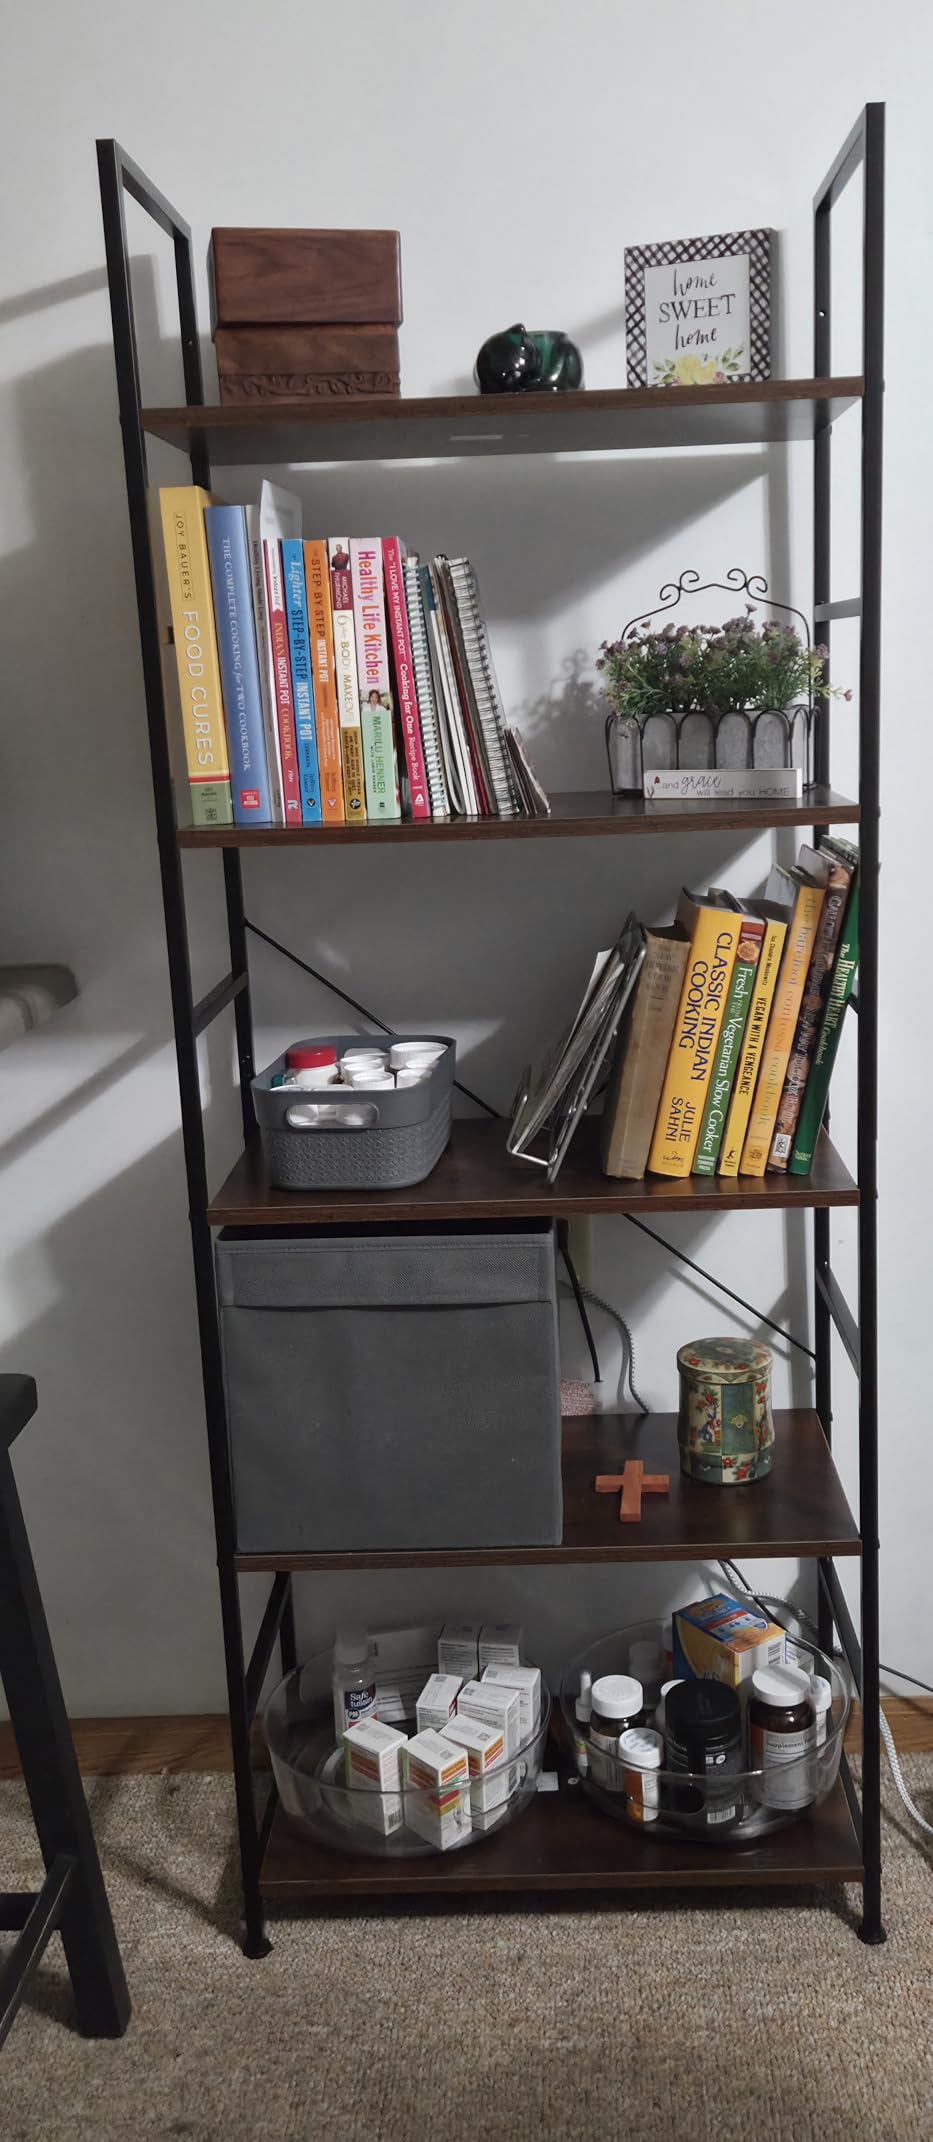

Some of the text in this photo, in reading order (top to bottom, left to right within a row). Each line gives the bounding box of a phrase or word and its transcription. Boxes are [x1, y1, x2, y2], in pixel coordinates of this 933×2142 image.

[673, 268, 718, 297] home
[658, 293, 736, 324] SWEET
[674, 324, 718, 351] home
[175, 513, 192, 600] JOY BAUER'S
[288, 561, 303, 607] Lighter
[334, 572, 342, 609] THURMOND
[341, 576, 349, 604] MICHAEL
[389, 569, 398, 591] LOVE
[392, 592, 399, 603] MY
[358, 551, 383, 684] Healthy Life Kitchen
[394, 605, 403, 637] INSTANT
[181, 610, 204, 677] FOOD
[222, 537, 251, 772] THE COMPLETE COOKING for TWO COOKBOOK
[274, 622, 285, 656] INDIAN
[291, 609, 307, 679] STEP-BY-STEP
[317, 639, 328, 668] INSTANT
[277, 656, 289, 688] INSTANT
[319, 669, 329, 683] POT
[400, 663, 410, 700] Cooking
[279, 690, 290, 705] POT
[296, 682, 311, 720] INSTANT
[404, 701, 412, 714] for
[190, 686, 214, 766] CURES
[280, 707, 293, 760] COOKBOOK
[299, 723, 313, 740] POT
[406, 715, 414, 734] One
[372, 716, 386, 794] MARILU HENNER
[407, 736, 416, 761] Recipe
[411, 762, 419, 781] Book
[680, 775, 722, 796] grace
[759, 787, 790, 797] HOME
[767, 943, 776, 961] Chandra
[787, 927, 812, 985] barefoot
[840, 943, 850, 958] The
[733, 967, 753, 998] Fresh
[762, 962, 772, 986] Moskowitz
[831, 958, 855, 999] HEALTHY
[678, 961, 709, 1049] COOKING
[691, 932, 733, 1081] CLASSIC INDIAN
[735, 1000, 743, 1018] FROM
[754, 997, 768, 1022] VEGAN
[773, 989, 795, 1053] contessa
[824, 997, 845, 1028] HEART
[718, 1016, 743, 1076] Vegetarian
[750, 1024, 763, 1042] WITH
[815, 1027, 830, 1065] Cookbook
[739, 1052, 756, 1096] VENGEANCE
[712, 1079, 730, 1107] Slow
[758, 1056, 782, 1126] cookbook
[665, 1096, 684, 1142] SAHNI
[678, 1102, 696, 1143] JULIE
[703, 1109, 723, 1153] Cooker
[350, 1690, 369, 1701] Safe
